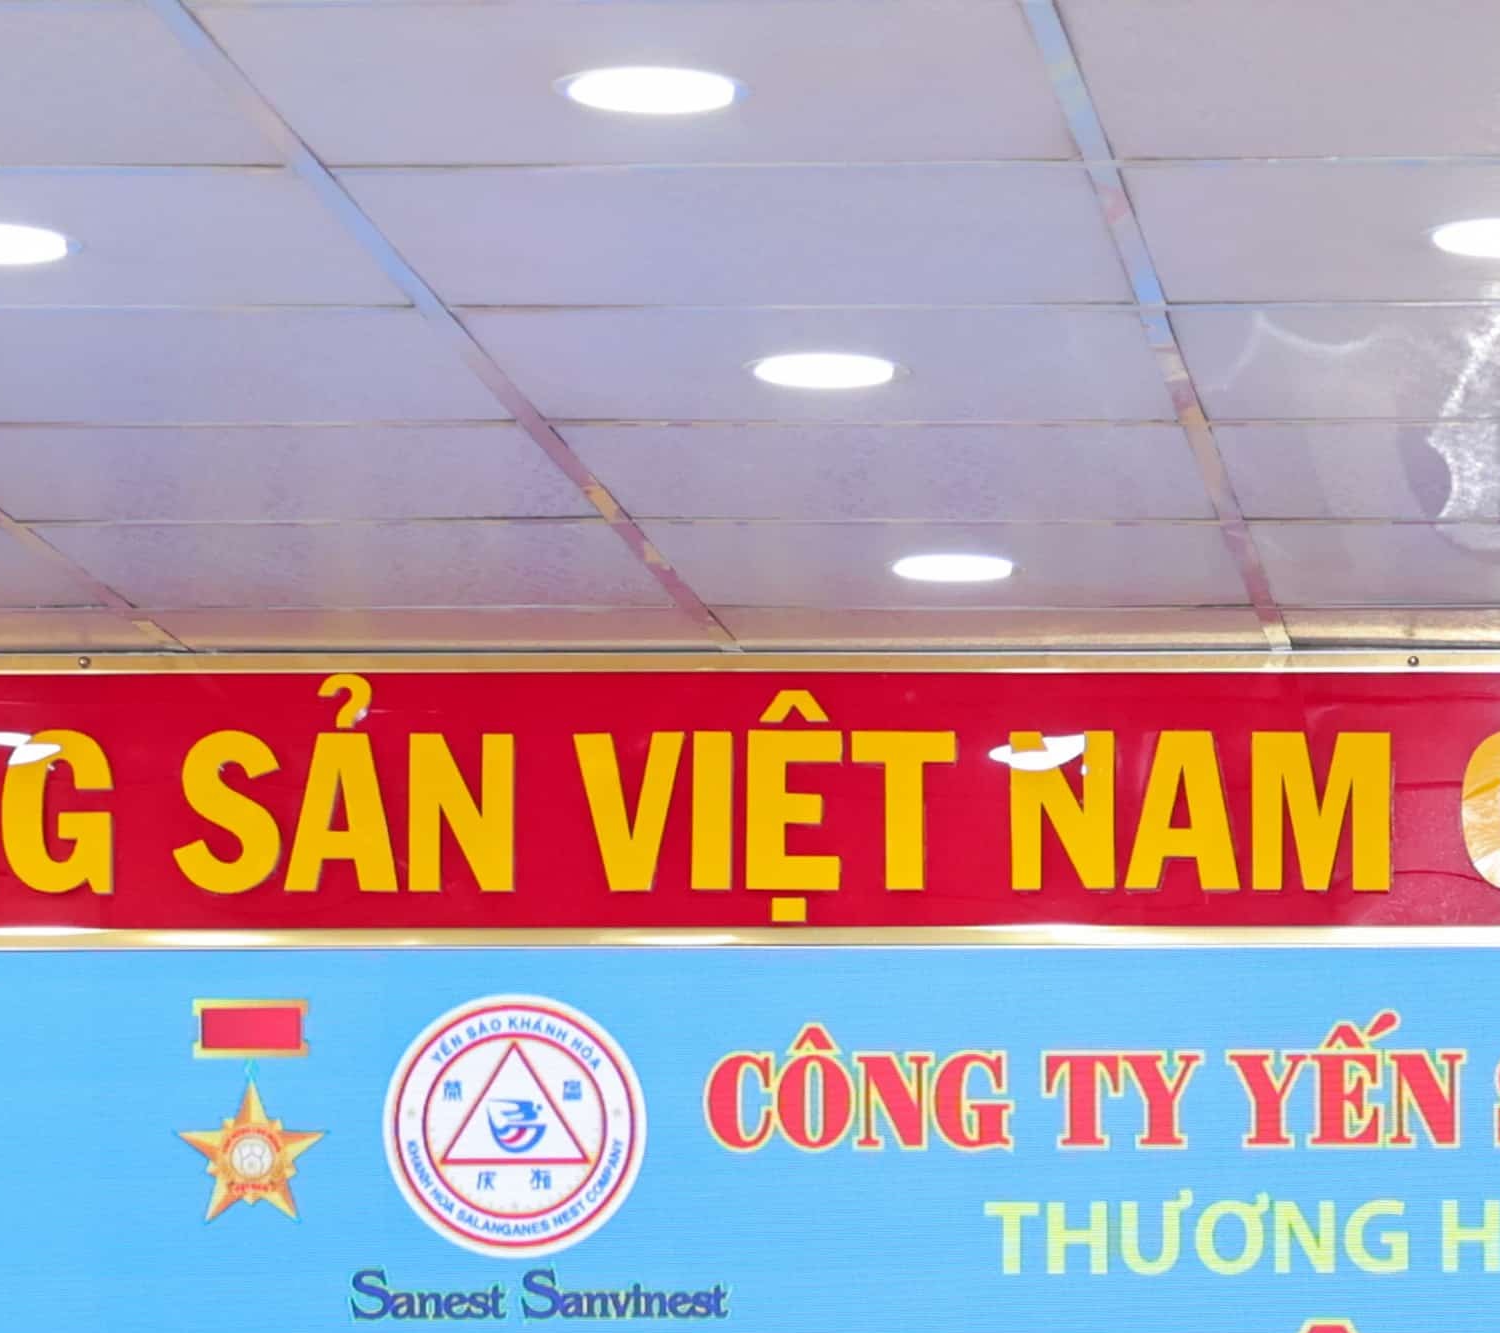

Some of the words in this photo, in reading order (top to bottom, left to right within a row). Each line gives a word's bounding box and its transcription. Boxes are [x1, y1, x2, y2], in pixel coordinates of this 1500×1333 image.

[174, 674, 514, 893] SẢN
[573, 690, 955, 921] VIỆT
[1009, 730, 1391, 893] NAM
[705, 1024, 1013, 1152] CÔNG
[1042, 1049, 1204, 1149] TY
[1227, 1010, 1465, 1149] YẾN
[553, 1199, 586, 1228] NEST
[586, 1138, 624, 1202] COMPANY
[984, 1189, 1408, 1274] THƯƠNG
[350, 1268, 507, 1320] Sanest
[521, 1266, 730, 1320] Sanvinest
